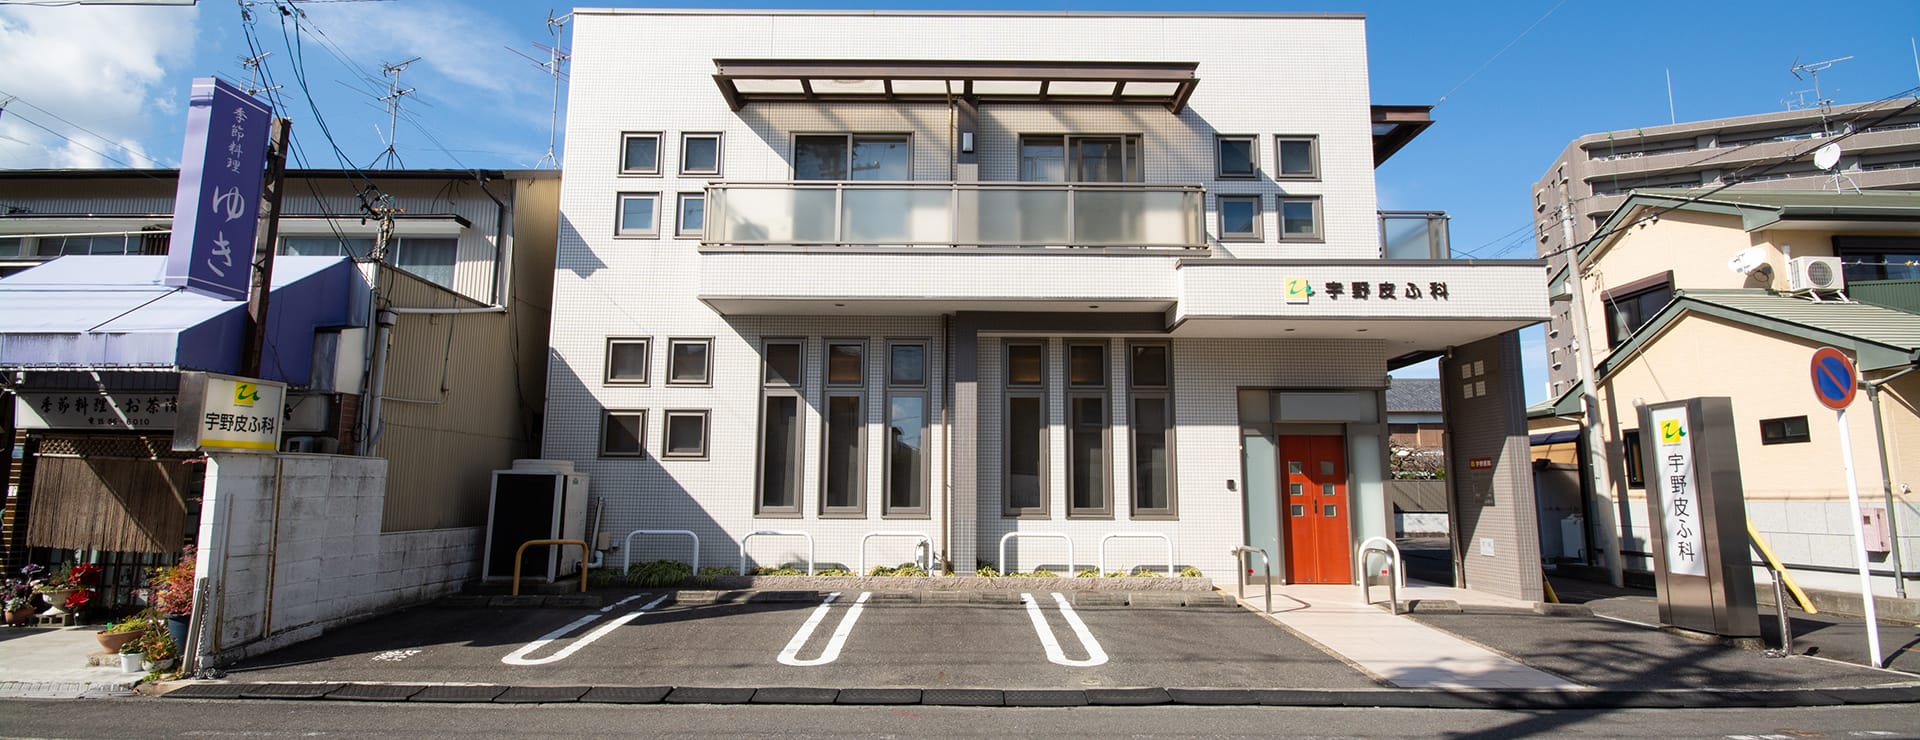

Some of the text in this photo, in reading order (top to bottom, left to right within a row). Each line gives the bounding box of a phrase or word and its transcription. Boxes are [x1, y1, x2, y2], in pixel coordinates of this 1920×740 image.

[226, 107, 248, 174] 季節料理
[208, 185, 245, 277] ゆき
[1325, 281, 1449, 301] 宇野皮ふ科
[205, 412, 275, 434] 宇野皮ふ科
[1668, 454, 1695, 562] 宇野皮ふ科
